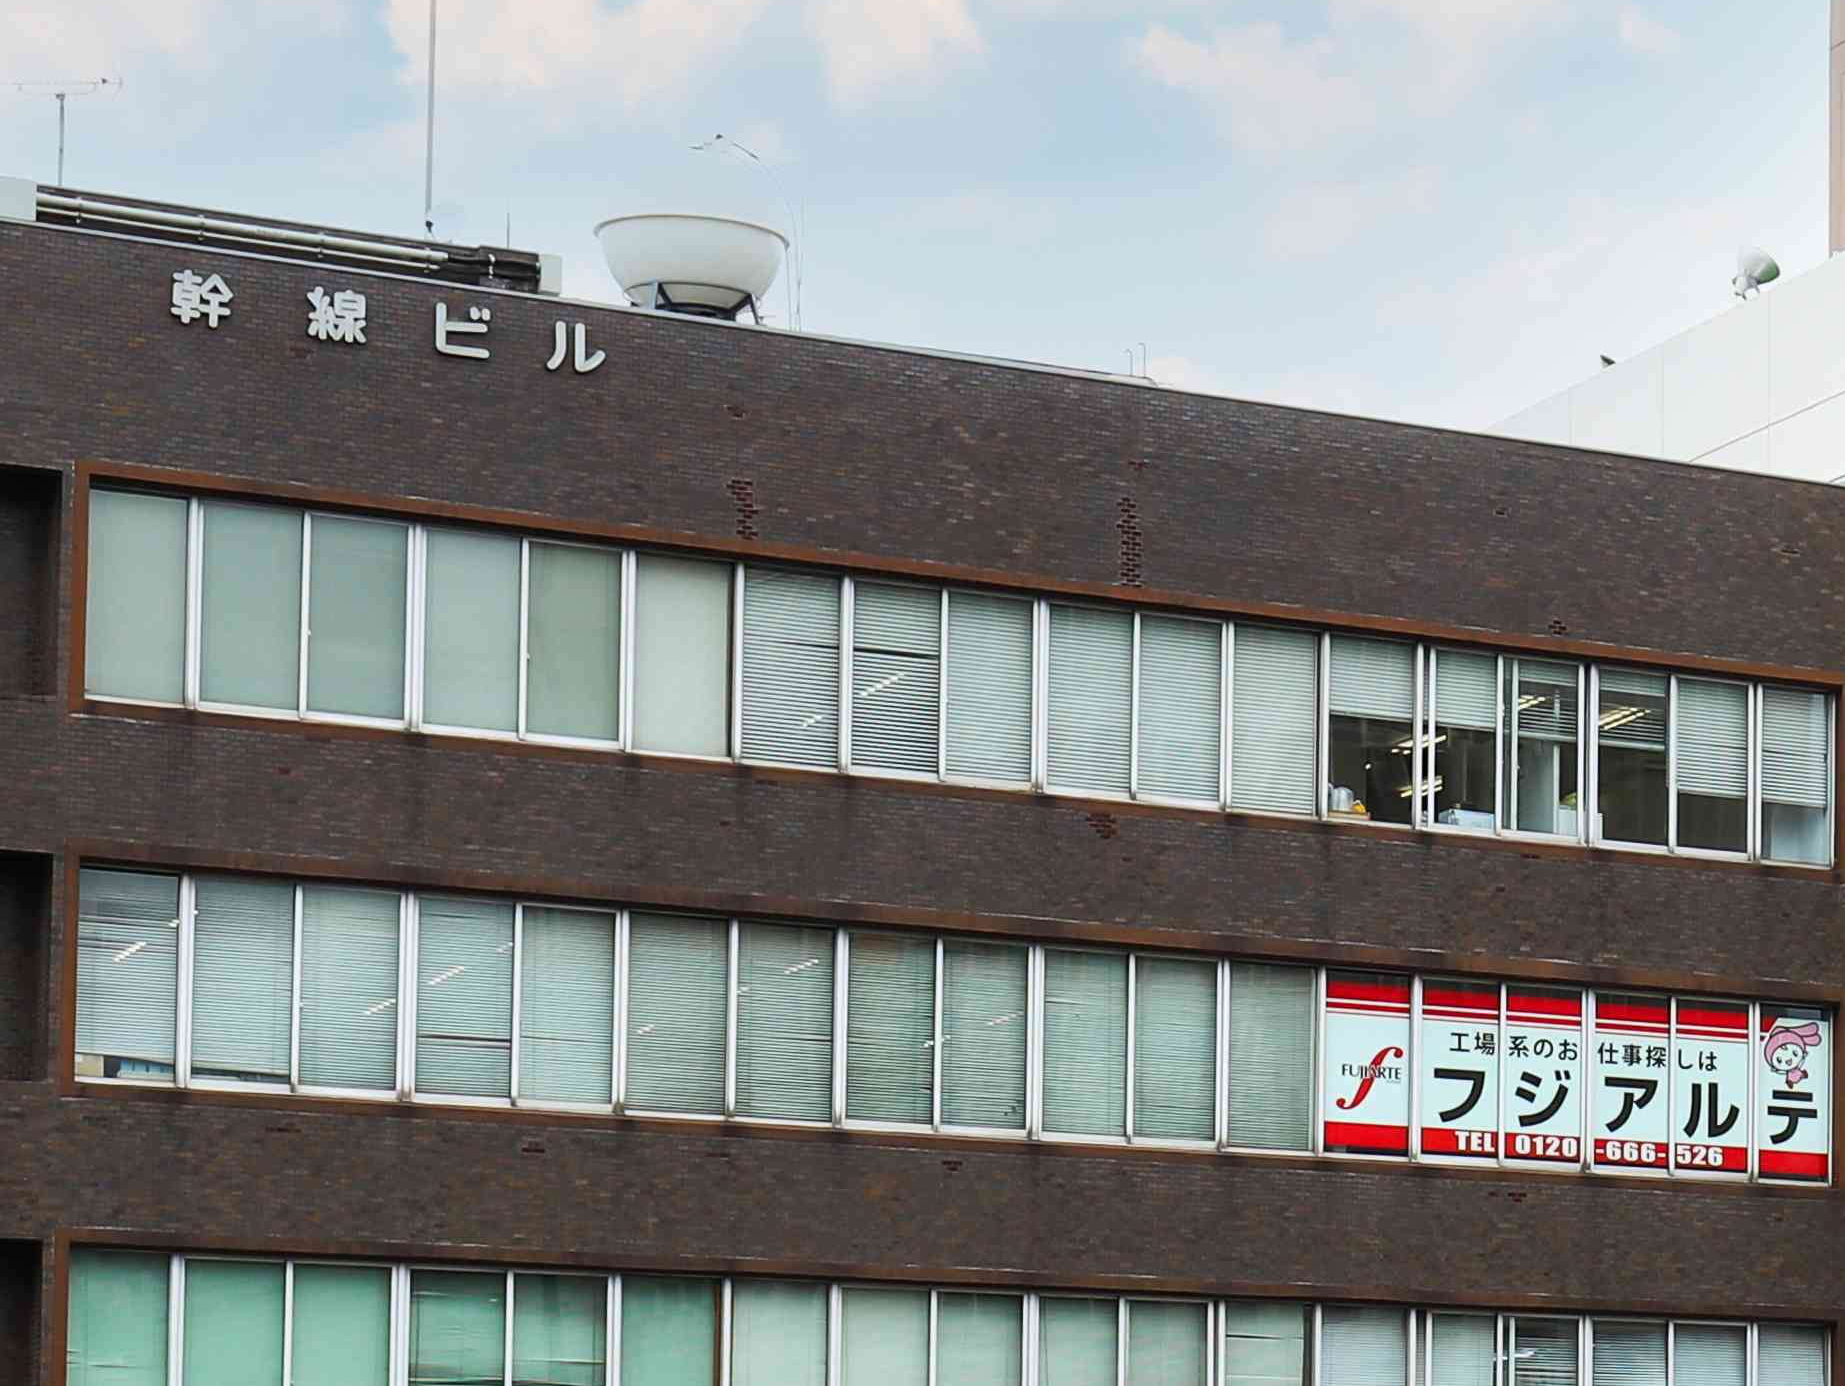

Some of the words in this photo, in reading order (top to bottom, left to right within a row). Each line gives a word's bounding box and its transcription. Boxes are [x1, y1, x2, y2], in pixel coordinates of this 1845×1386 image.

[171, 268, 606, 374] 幹線ビル
[1449, 1030, 1718, 1071] 工場系のお仕事探しは
[1433, 1066, 1819, 1146] フジアルテ
[1455, 1130, 1495, 1153] TEL
[1515, 1133, 1723, 1168] 0120-666-526
